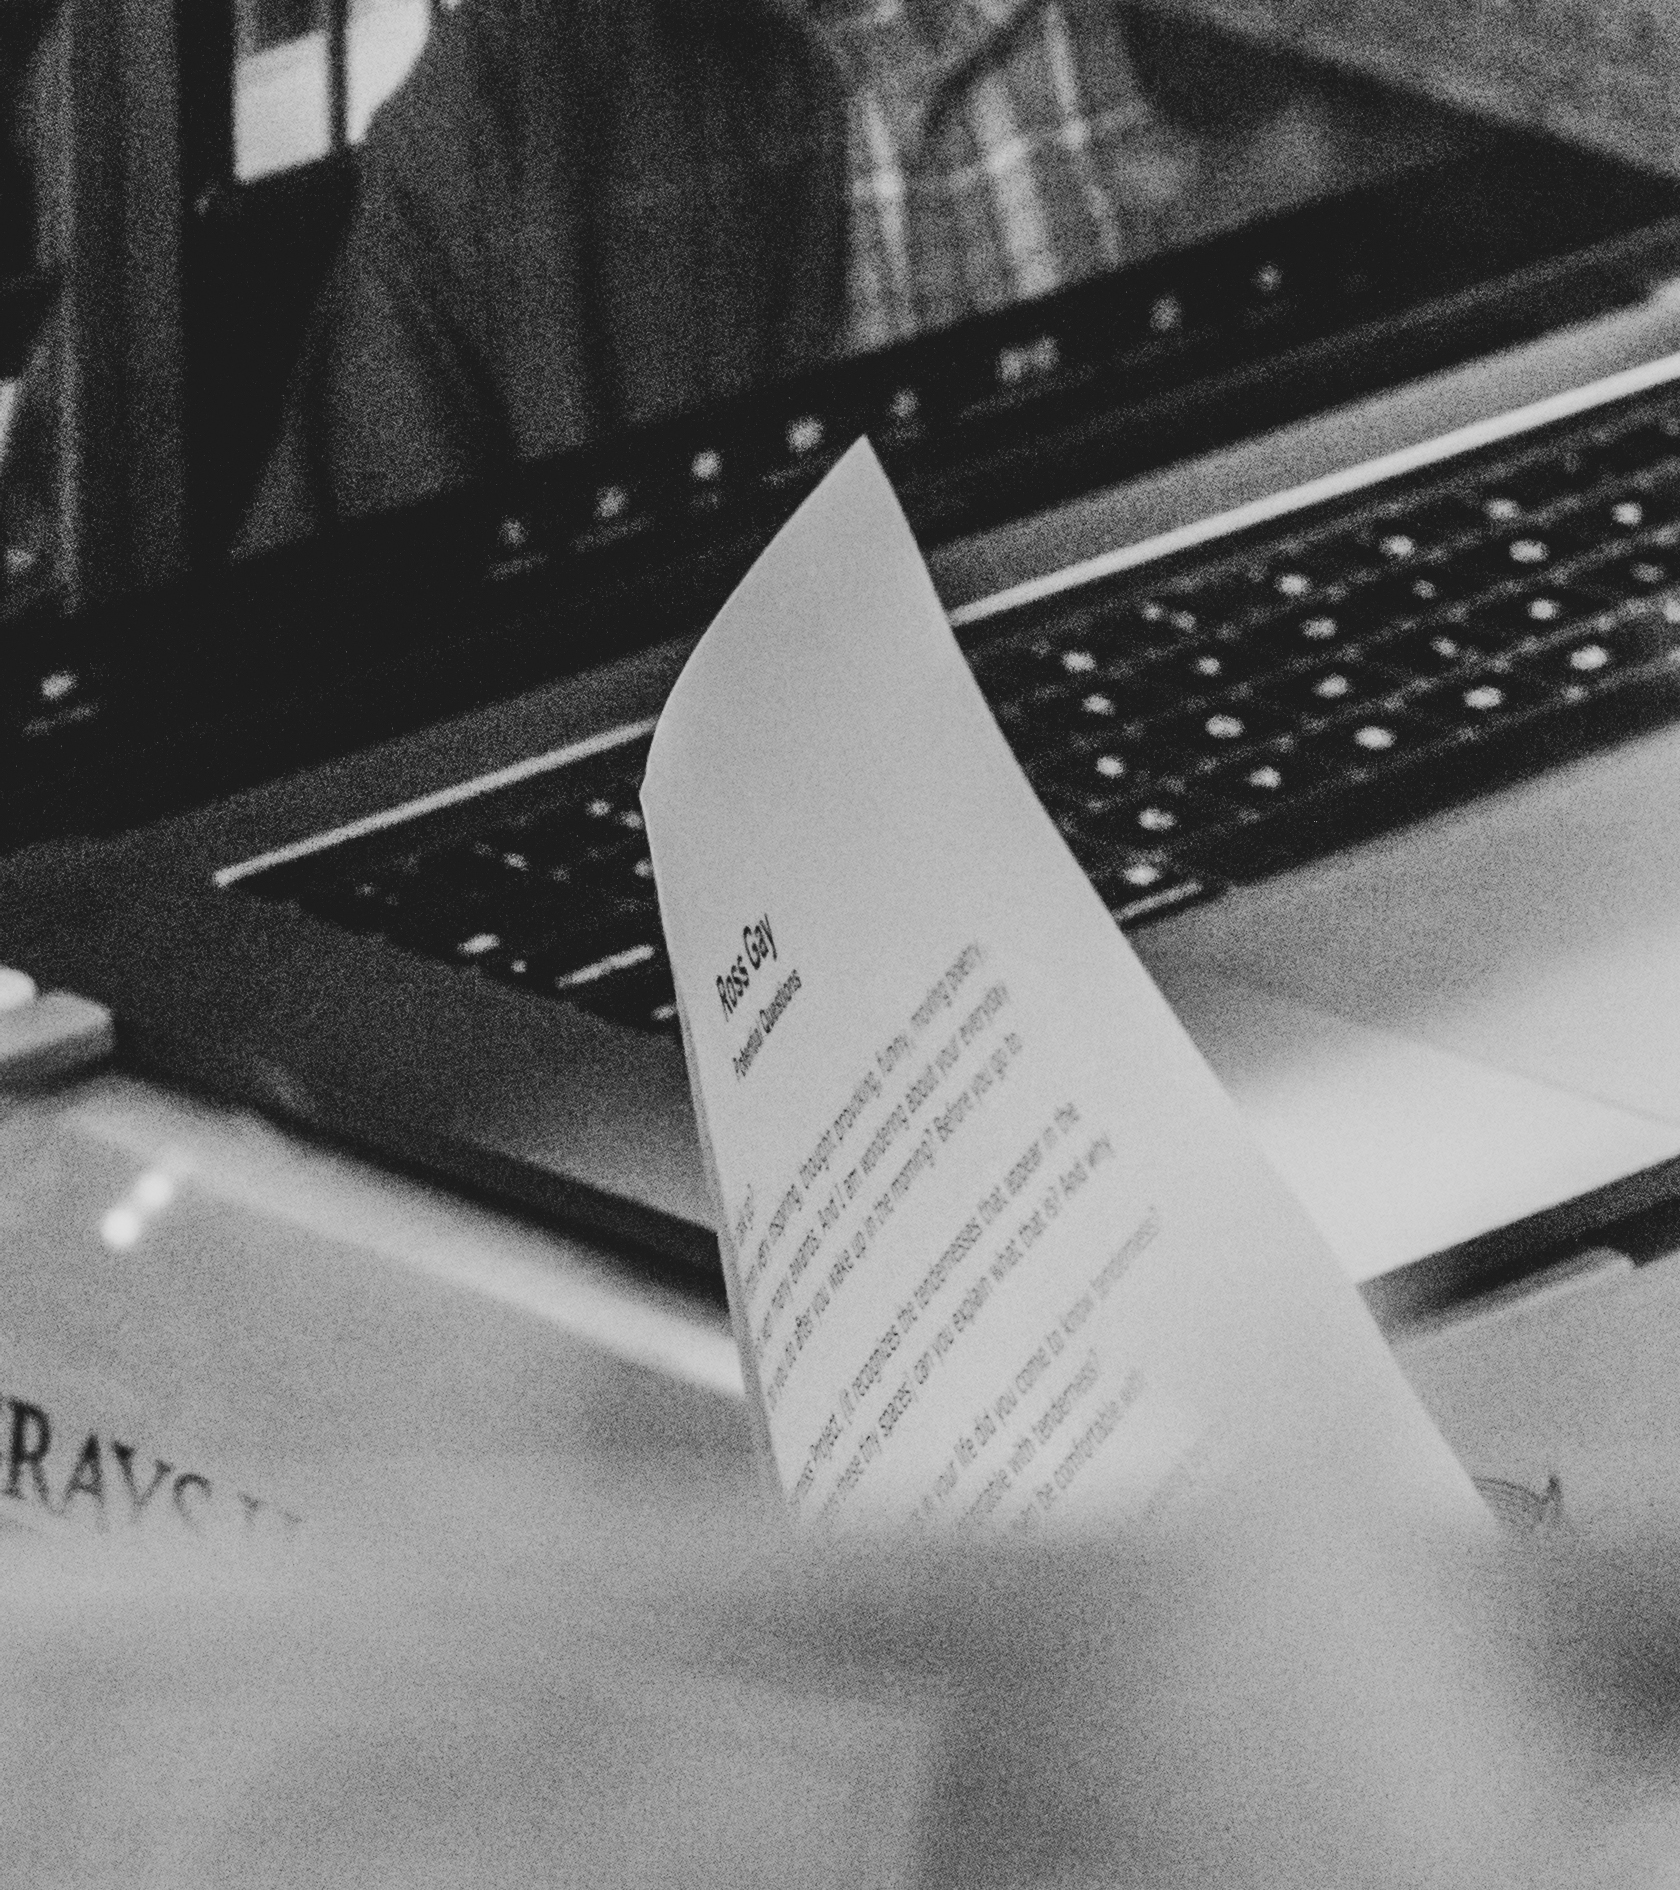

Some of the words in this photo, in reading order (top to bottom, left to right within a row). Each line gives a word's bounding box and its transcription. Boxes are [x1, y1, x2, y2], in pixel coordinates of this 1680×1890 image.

[716, 954, 750, 1023] Ross
[743, 913, 778, 971] Gay
[759, 969, 802, 1034] Questions
[909, 978, 953, 1030] moving
[817, 1193, 840, 1232] And
[859, 1103, 910, 1176] wondering
[904, 1064, 939, 1115] about
[934, 1034, 961, 1077] your
[958, 982, 1010, 1047] everyday
[793, 1307, 813, 1351] after
[810, 1284, 831, 1318] you
[828, 1248, 855, 1291] wake
[872, 1191, 895, 1225] the
[889, 1127, 935, 1200] morning?
[932, 1091, 974, 1144] Before
[969, 1065, 994, 1104] you
[989, 1048, 1009, 1082] go
[1003, 1032, 1023, 1056] to
[913, 1350, 933, 1386] can
[930, 1325, 955, 1362] you
[951, 1276, 992, 1334] explain
[989, 1238, 1024, 1282] what
[1017, 1209, 1048, 1249] that
[1042, 1185, 1062, 1218] is?
[1058, 1157, 1089, 1199] And
[1083, 1133, 1115, 1169] why
[851, 1324, 901, 1401] recognizes
[912, 1216, 983, 1310] tendernesses
[977, 1185, 1010, 1226] that
[1003, 1140, 1043, 1197] appear
[953, 1436, 978, 1467] life
[974, 1410, 997, 1447] did
[993, 1388, 1018, 1426] you
[1014, 1346, 1051, 1395] come
[1044, 1329, 1065, 1357] to
[1059, 1293, 1094, 1336] know
[1053, 1400, 1123, 1490] comfortable
[1007, 1435, 1036, 1475] with
